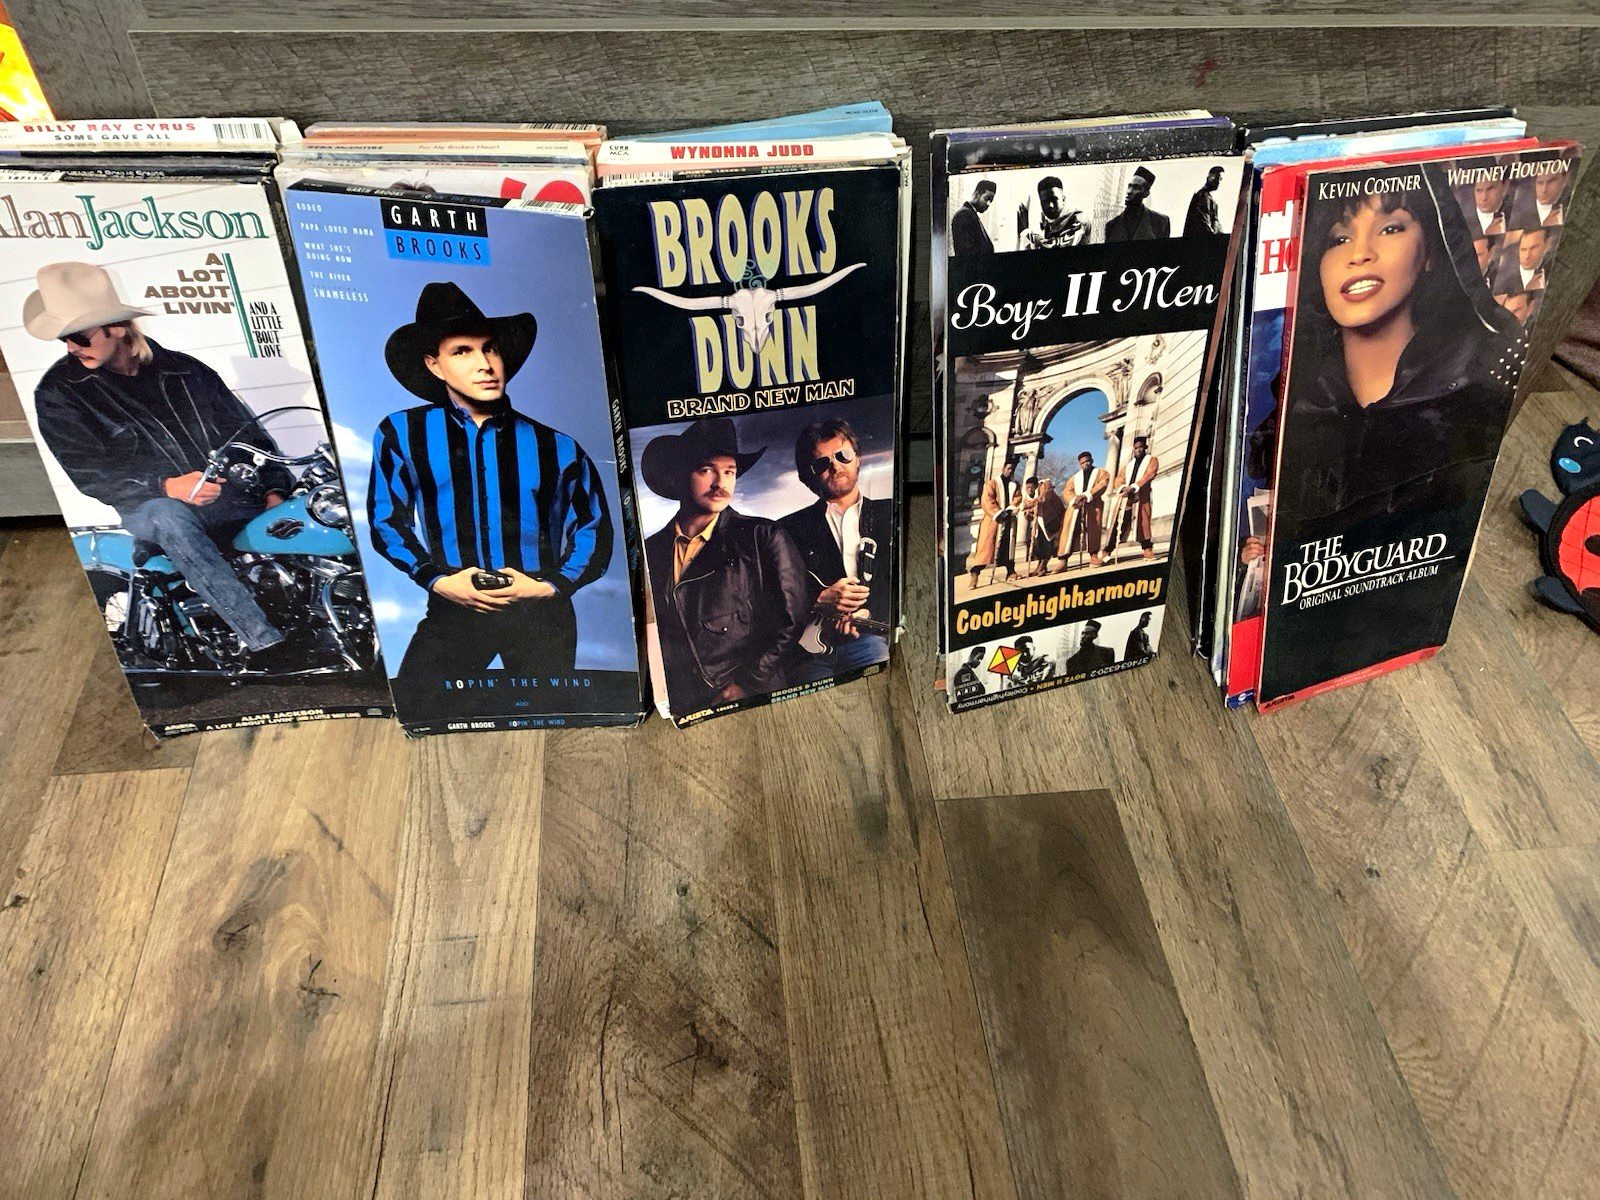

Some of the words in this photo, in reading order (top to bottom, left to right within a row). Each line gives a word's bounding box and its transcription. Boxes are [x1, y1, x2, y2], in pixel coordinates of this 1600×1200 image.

[24, 124, 76, 133] BILLY
[87, 124, 122, 132] RAY
[134, 123, 196, 132] CYRUS
[670, 146, 759, 159] WYNONNA
[767, 145, 814, 156] JUDD
[1448, 162, 1507, 186] WHITNEY
[1509, 159, 1572, 180] HOUSTON
[1318, 180, 1360, 200] KEVIN
[1364, 174, 1421, 195] COSTNER
[296, 203, 322, 212] RODEO
[390, 205, 477, 231] GARTH
[300, 222, 319, 230] PAPA
[324, 225, 348, 234] LOVED
[353, 228, 374, 236] MAMA
[646, 187, 836, 288] BROOKS
[304, 242, 324, 250] WHAT
[330, 244, 351, 253] SHE'S
[396, 236, 481, 260] BROOKS
[205, 253, 223, 265] A
[306, 252, 330, 261] DOING
[177, 269, 225, 282] LOT
[310, 271, 324, 279] THE
[329, 273, 351, 281] RIVER
[144, 286, 230, 298] ABOUT
[314, 288, 368, 302] SHAMELESS
[163, 302, 235, 314] LIVIN'
[249, 302, 268, 315] AND
[270, 302, 277, 315] A
[951, 282, 1054, 341] Boyz
[1062, 270, 1107, 318] II
[1112, 265, 1219, 312] Men
[251, 316, 283, 329] LITTLE
[252, 331, 280, 343] 'BOUT
[258, 345, 283, 358] LOVE
[689, 305, 820, 394] DUNN
[667, 393, 750, 418] BRAND
[754, 386, 800, 408] NEW
[805, 378, 855, 400] MAN
[611, 398, 622, 433] GARTH
[615, 436, 628, 474] BROOKS
[1300, 535, 1343, 565] THE
[1281, 533, 1446, 605] BODYGUARD
[1300, 588, 1342, 610] ORIGINAL
[1344, 572, 1405, 598] SOUNDTRACK
[1406, 565, 1439, 582] ALBUM
[956, 577, 1162, 635] Cooleyhighharmony
[445, 678, 498, 690] ROPIN'
[511, 678, 538, 687] THE
[550, 678, 591, 687] WIND
[1064, 673, 1086, 683] BOYZ
[772, 684, 802, 697] BROOKS
[812, 677, 834, 686] DUNN
[1036, 681, 1054, 690] MEN
[770, 692, 798, 703] BRAND
[799, 688, 816, 696] NEW
[818, 683, 835, 692] MAN
[957, 687, 1028, 709] Cooleyhighharmony
[242, 714, 270, 722] ALAN
[274, 709, 323, 718] JACKSON
[679, 708, 714, 724] ARISTA
